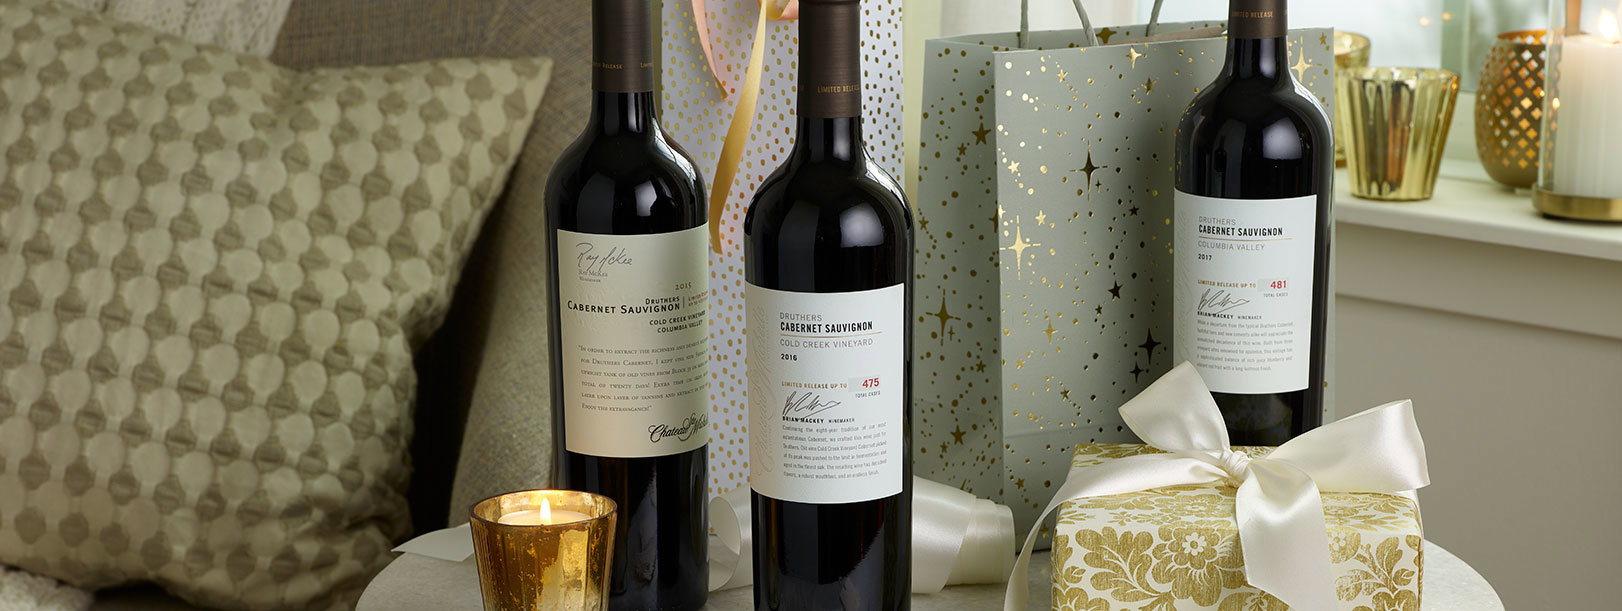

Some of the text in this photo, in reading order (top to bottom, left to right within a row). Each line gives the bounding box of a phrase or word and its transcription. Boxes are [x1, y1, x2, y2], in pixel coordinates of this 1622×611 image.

[1198, 216, 1236, 226] DRUTHERS
[1198, 224, 1283, 236] CABERNET SAUVIGNON
[1198, 240, 1234, 250] COLUMBIA
[675, 282, 692, 290] 2015
[1270, 280, 1288, 290] 481
[646, 296, 680, 305] DRUTHERS
[568, 300, 680, 314] CABERNET SAUVIGNON
[780, 312, 823, 322] DRUTHERS
[658, 324, 688, 333] COLUMBIA
[780, 321, 873, 333] CABERNET SAUVIGNON
[780, 338, 874, 348] COLD CREEK VINEYARD
[780, 353, 798, 361] 2016
[862, 378, 880, 388] 475
